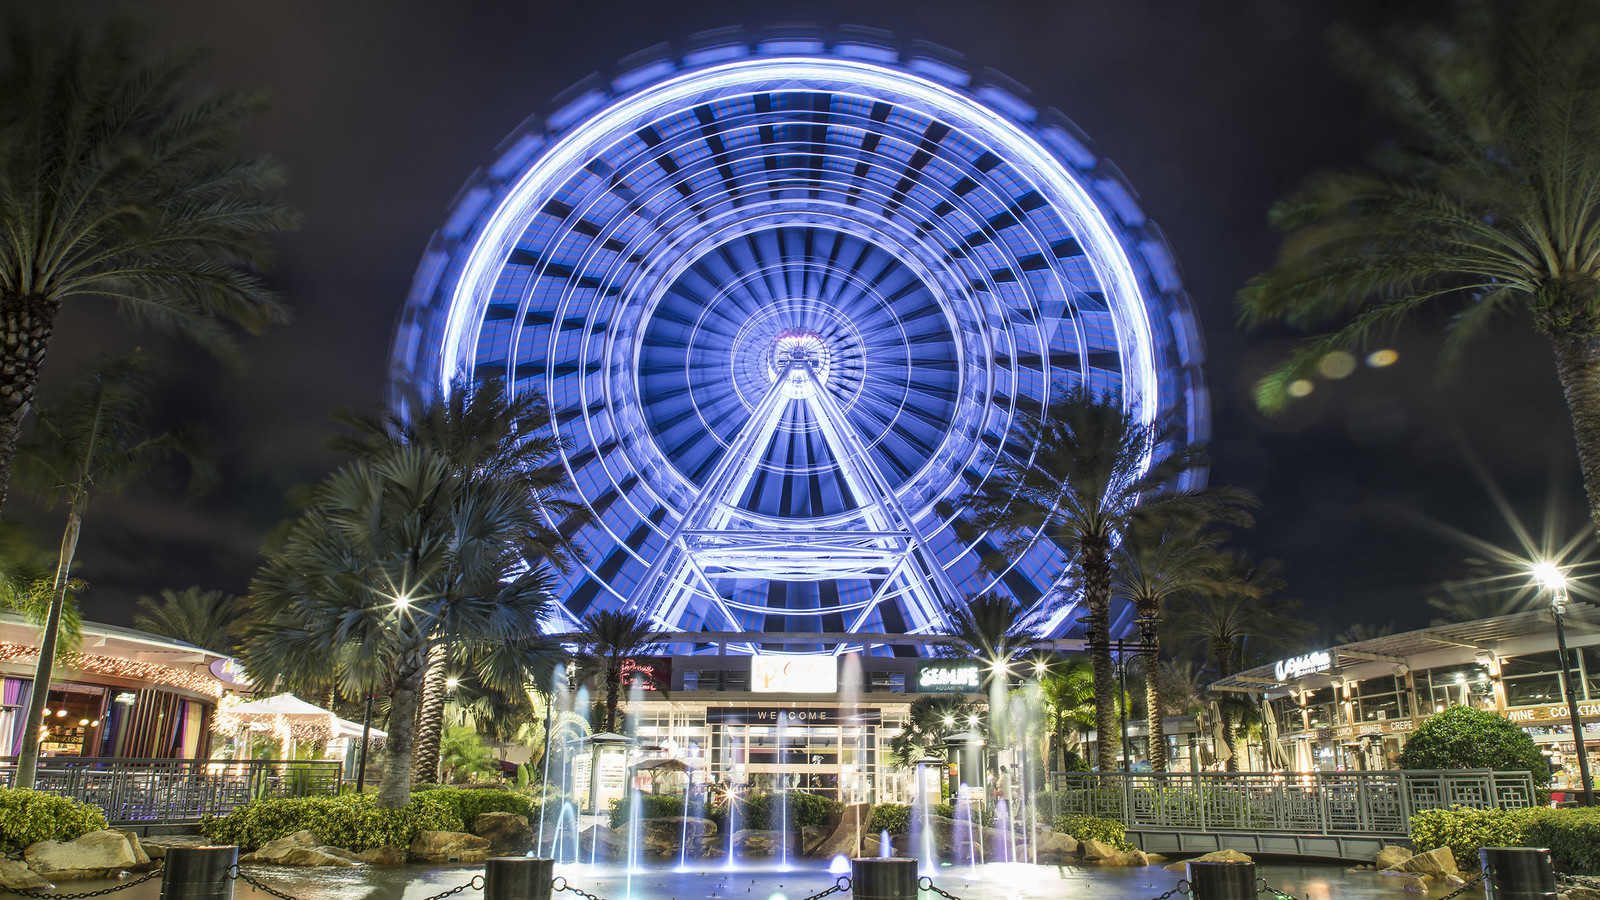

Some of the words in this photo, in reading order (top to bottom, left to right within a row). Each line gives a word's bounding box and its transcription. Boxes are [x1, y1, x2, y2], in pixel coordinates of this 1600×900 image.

[757, 711, 827, 720] WELCOME
[1507, 709, 1535, 720] WINE
[1336, 727, 1353, 736] LUNCH
[1359, 724, 1383, 734] DINNER
[1390, 720, 1413, 731] CREPE
